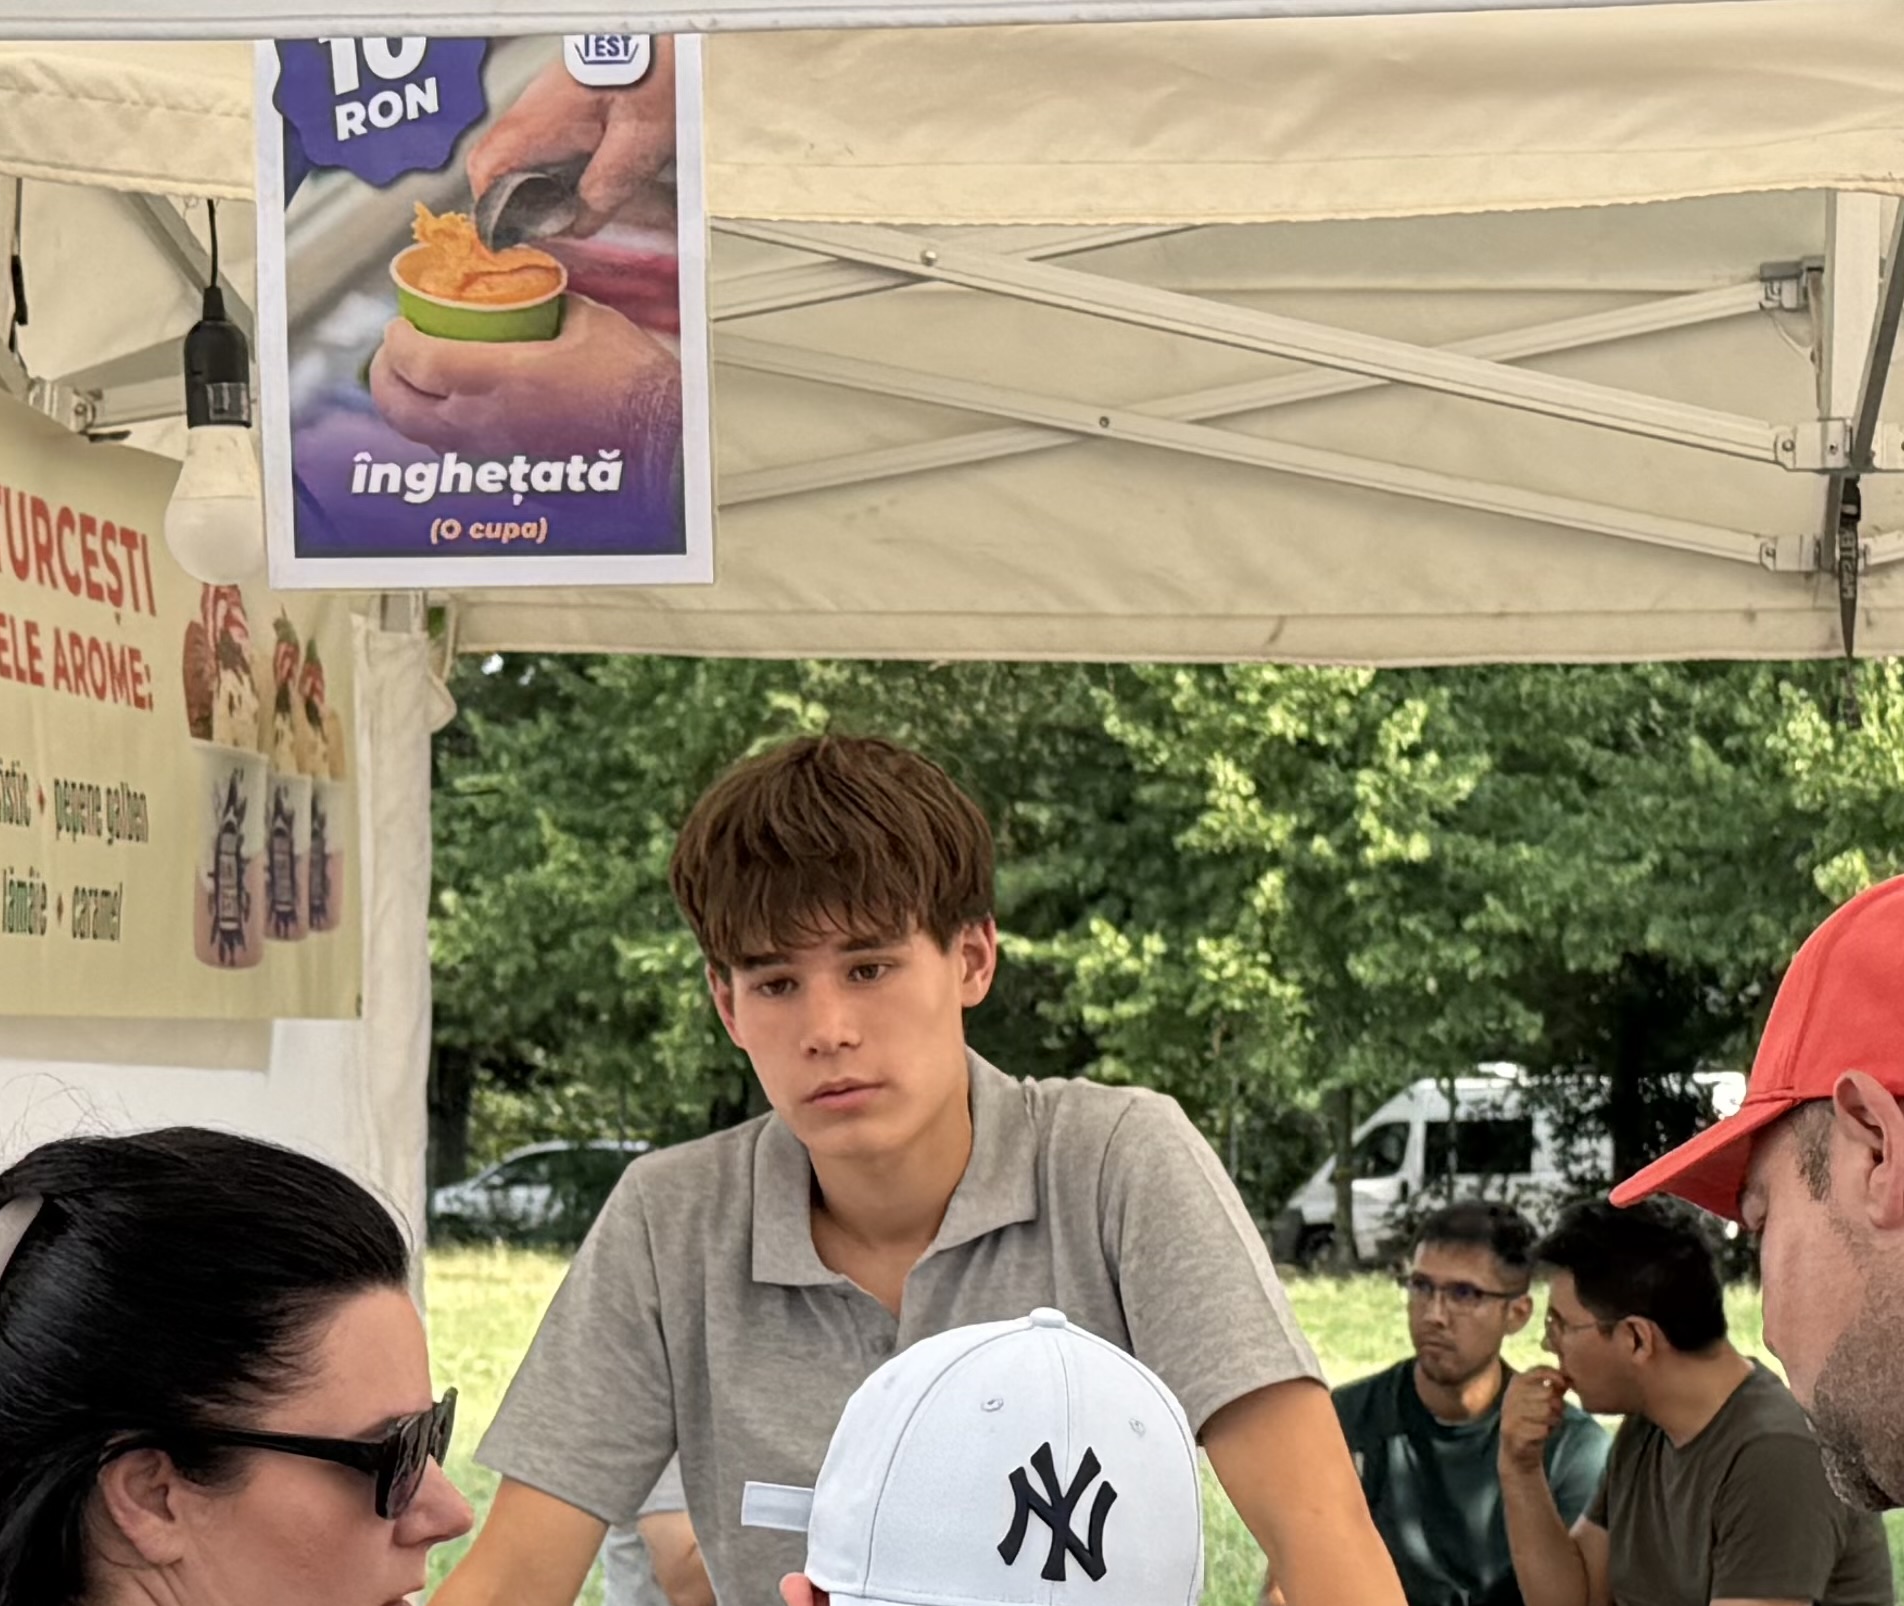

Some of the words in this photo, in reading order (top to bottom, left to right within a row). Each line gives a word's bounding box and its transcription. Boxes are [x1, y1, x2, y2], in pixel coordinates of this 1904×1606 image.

[335, 77, 438, 141] RON
[351, 449, 623, 505] înghețată
[469, 517, 548, 544] cupa)
[54, 627, 154, 712] AROME:
[996, 1441, 1118, 1582] NY
